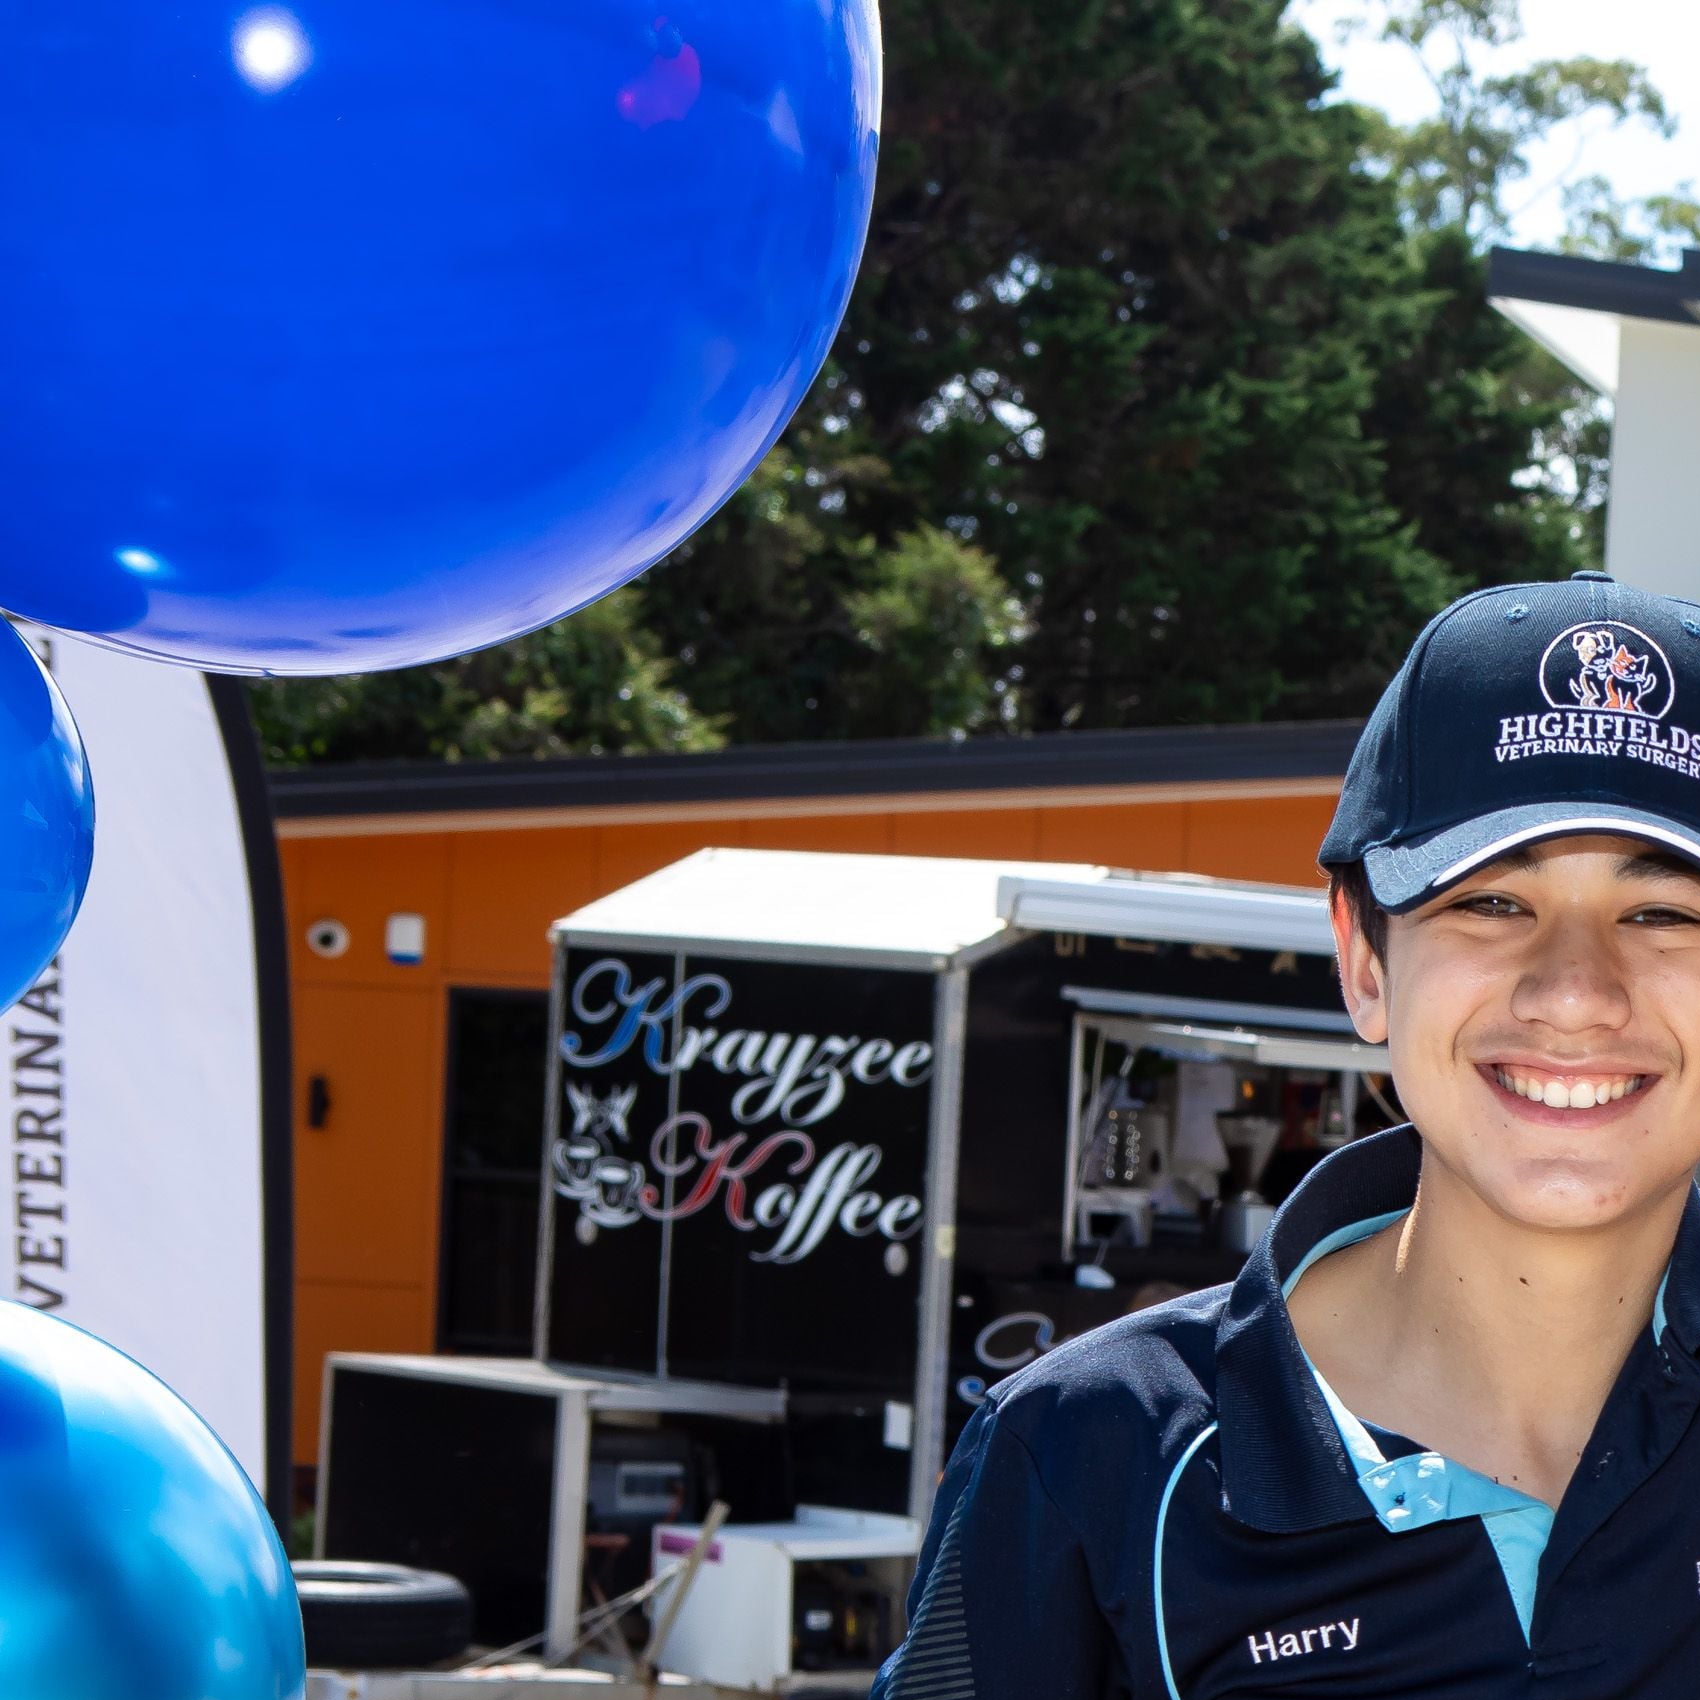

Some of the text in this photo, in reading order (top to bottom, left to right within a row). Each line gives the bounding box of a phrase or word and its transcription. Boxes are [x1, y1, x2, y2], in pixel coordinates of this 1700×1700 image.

[1494, 738, 1622, 762] VETERINARY
[559, 958, 933, 1127] Krayzee
[14, 953, 67, 1313] VETERINA
[638, 1111, 923, 1265] Koffee
[1247, 1618, 1360, 1664] Harry
